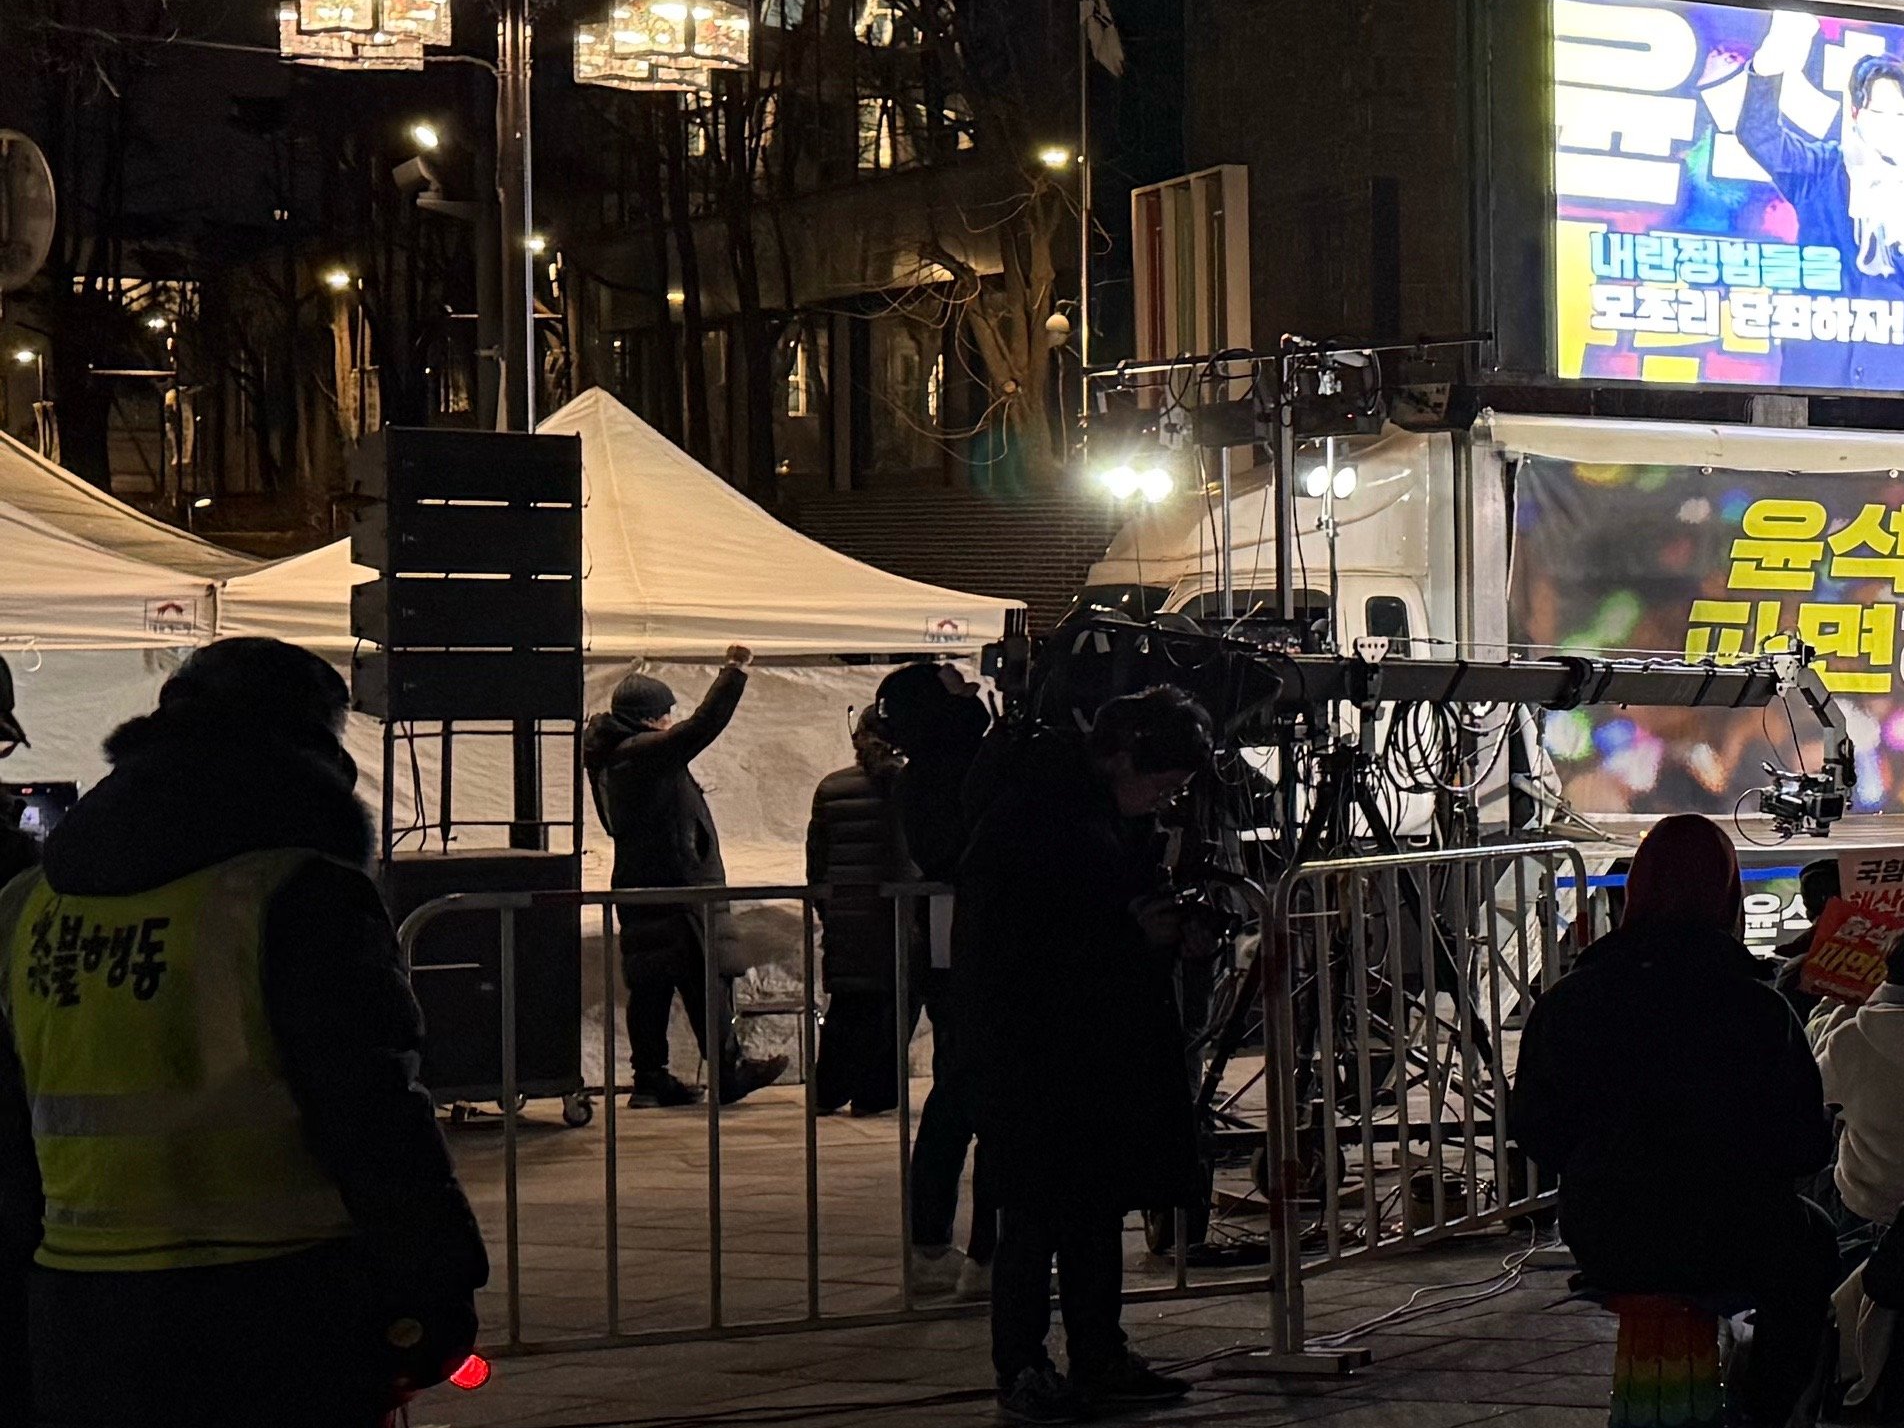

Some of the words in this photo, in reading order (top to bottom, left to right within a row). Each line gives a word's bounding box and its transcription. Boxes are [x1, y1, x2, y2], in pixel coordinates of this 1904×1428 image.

[1590, 231, 1841, 293] 내란정범들을
[1591, 284, 1723, 334] 모조리
[1730, 288, 1904, 345] 단죄하자!
[28, 914, 170, 1007] 촛불행동
